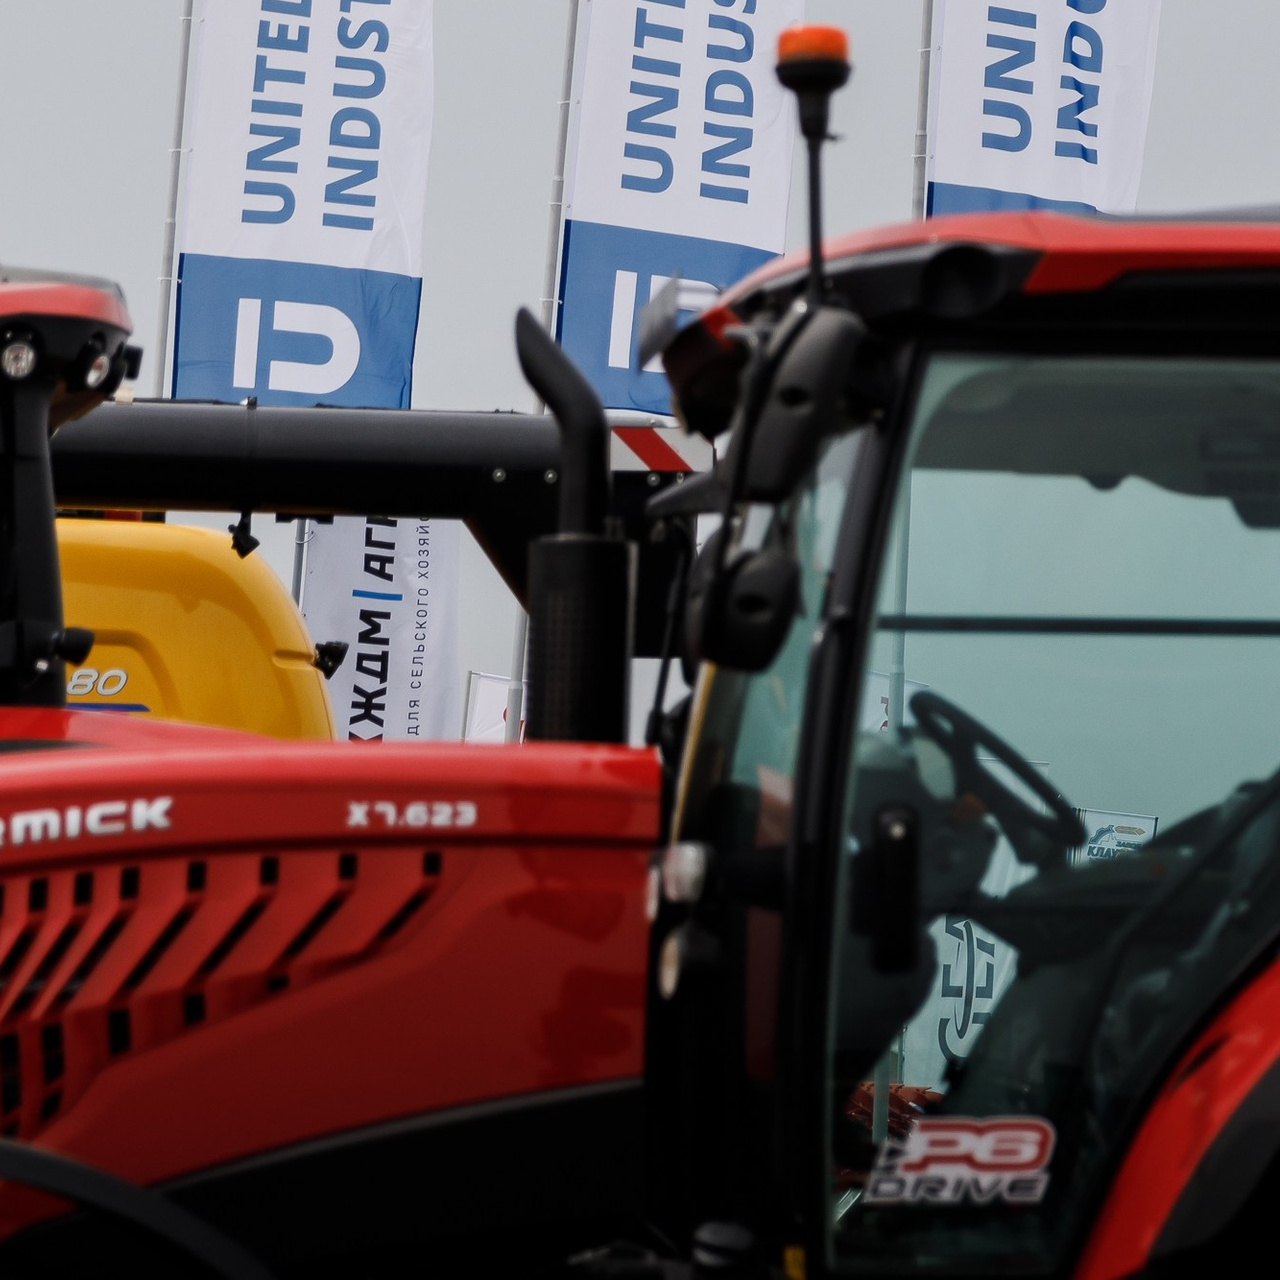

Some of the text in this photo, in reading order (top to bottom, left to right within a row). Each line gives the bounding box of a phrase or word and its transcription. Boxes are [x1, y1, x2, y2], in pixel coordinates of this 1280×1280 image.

[410, 588, 430, 689] СЕЛЬСКОГО
[66, 667, 129, 697] 80
[407, 699, 421, 736] ДЛЯ
[867, 1173, 1049, 1202] DRIVE
